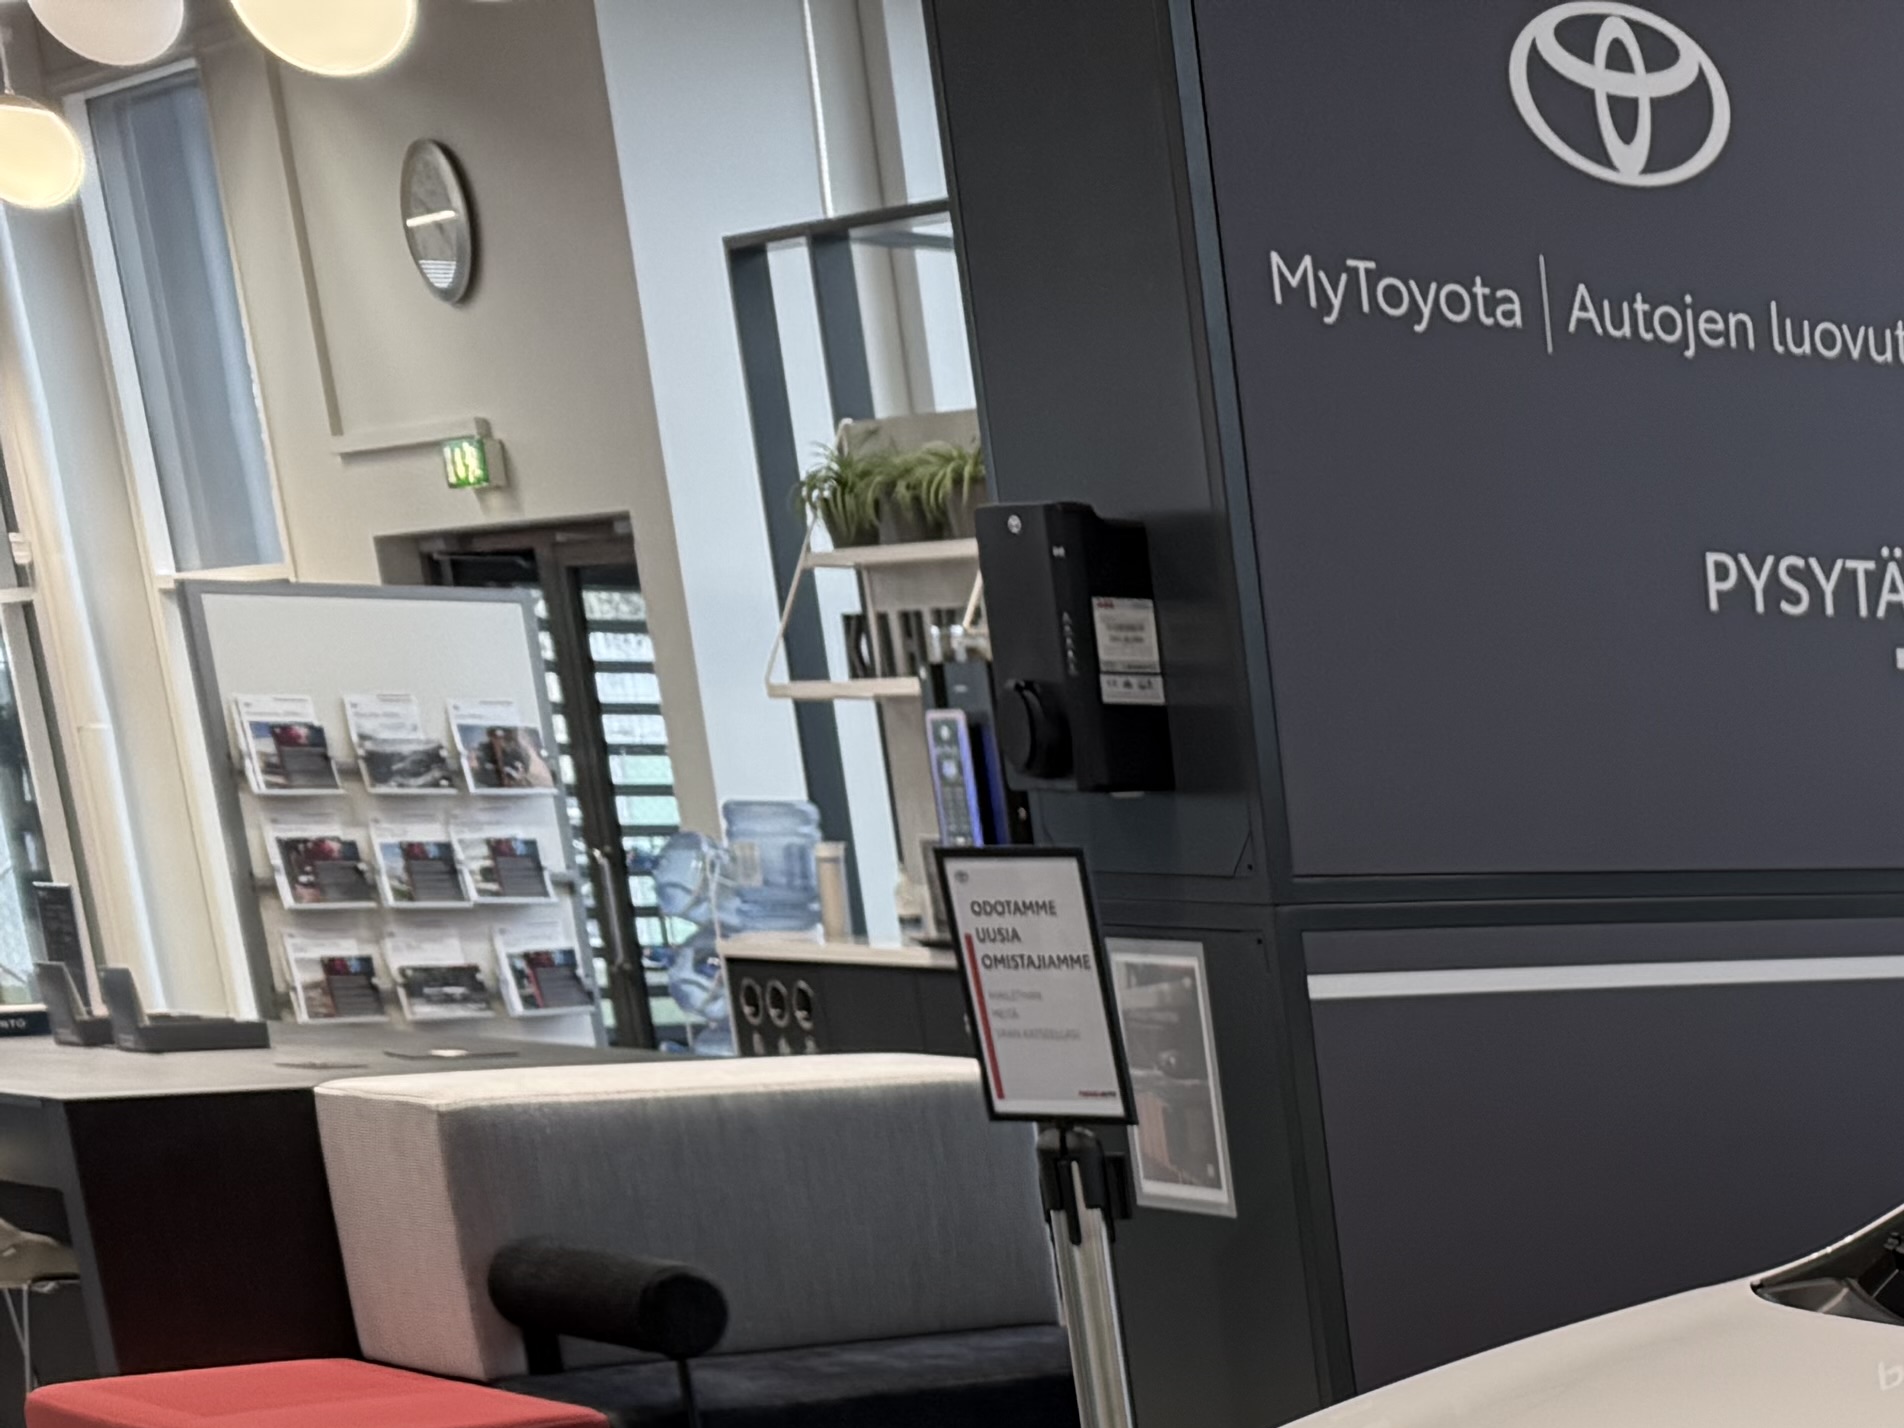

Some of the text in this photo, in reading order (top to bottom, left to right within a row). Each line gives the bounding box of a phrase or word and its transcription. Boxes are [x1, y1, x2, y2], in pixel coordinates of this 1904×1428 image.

[1269, 250, 1524, 333] MyToyota
[1567, 282, 1756, 360] Autojen
[970, 900, 1057, 917] ODOTAMME
[975, 927, 1021, 944] UUSIA
[981, 953, 1092, 971] OMISTAJIAMME
